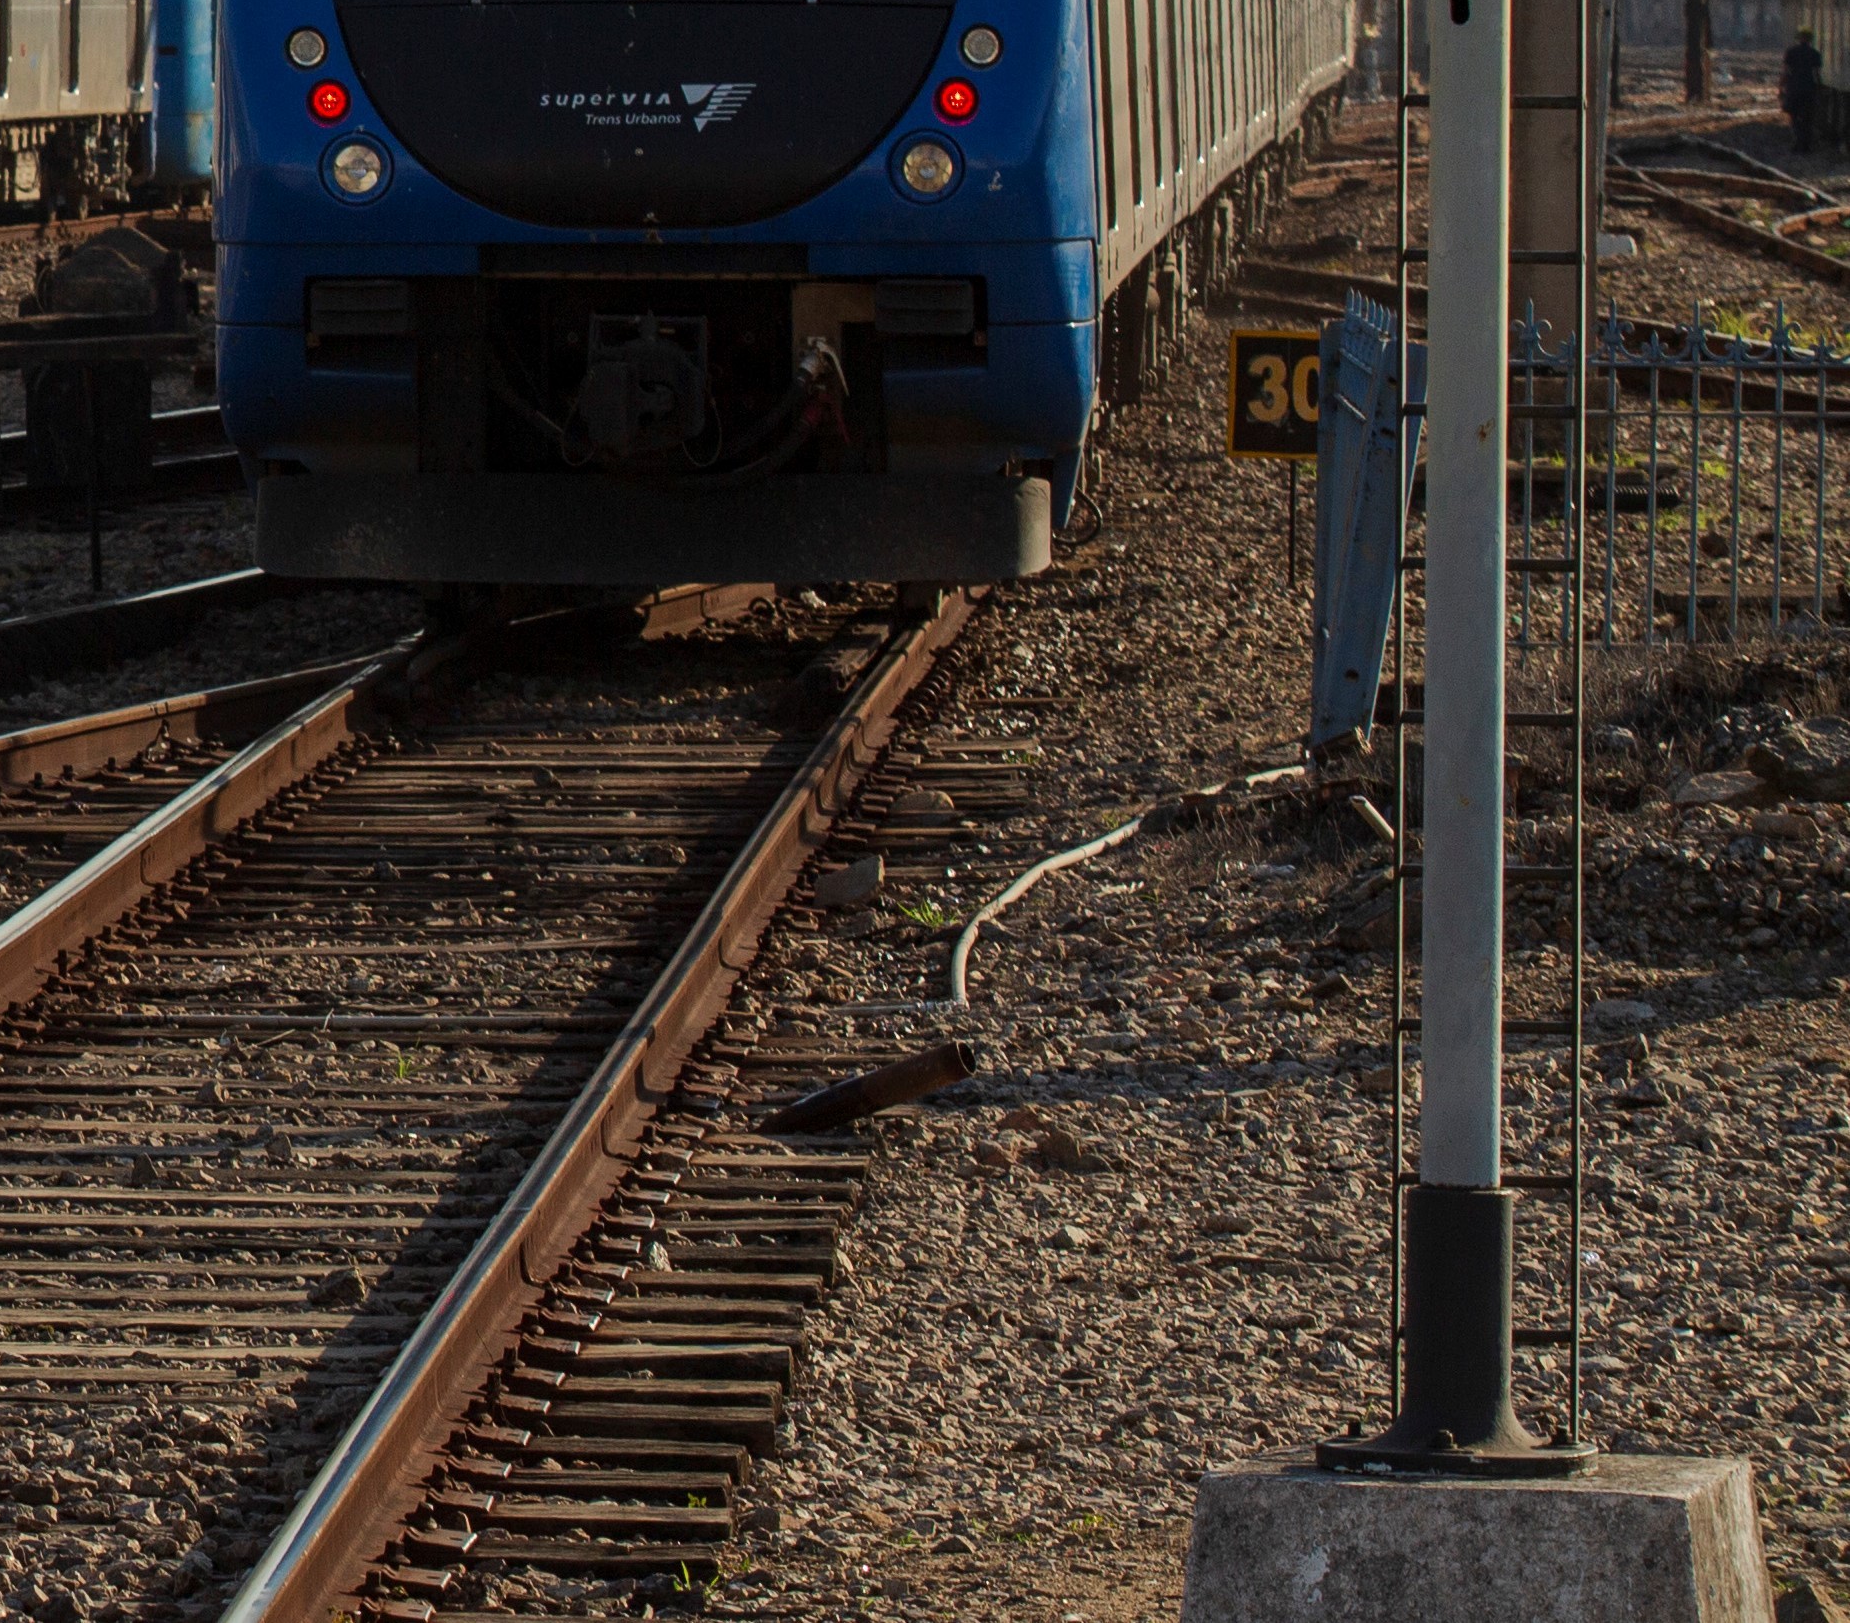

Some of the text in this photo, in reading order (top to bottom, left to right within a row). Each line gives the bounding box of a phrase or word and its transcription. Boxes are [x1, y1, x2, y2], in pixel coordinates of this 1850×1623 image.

[585, 113, 682, 125] Trens Urbanos
[1247, 354, 1321, 422] 30
